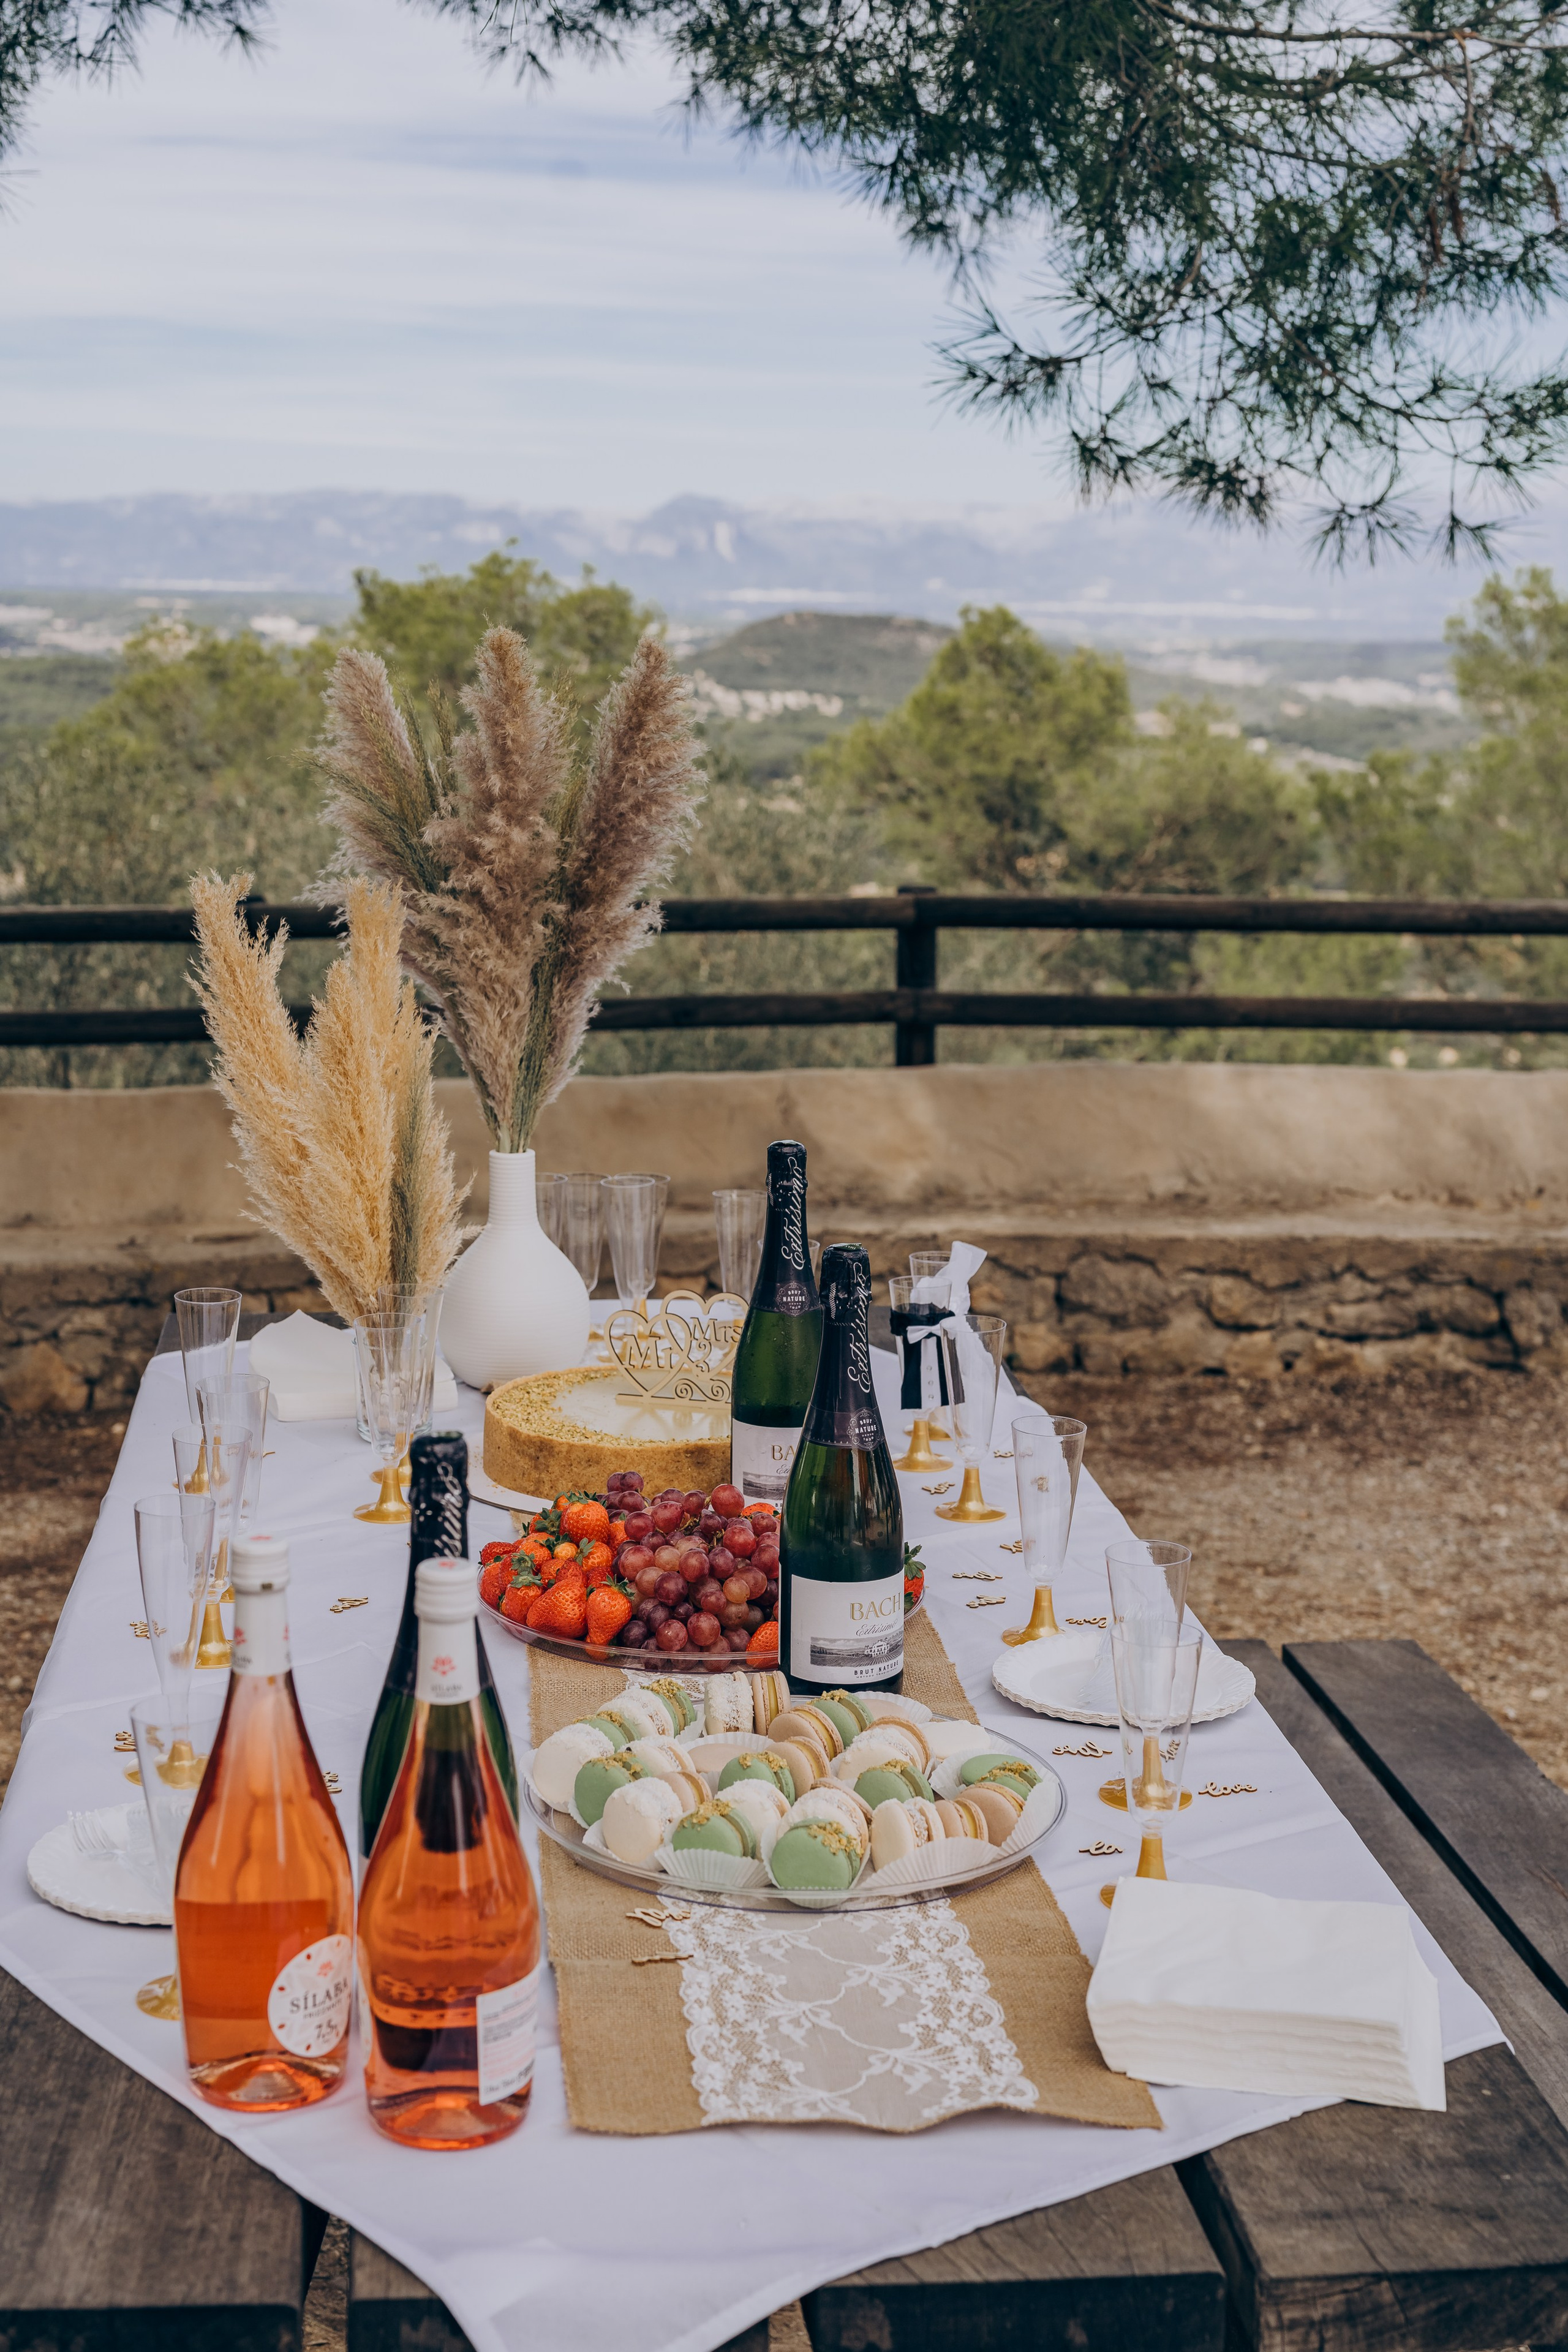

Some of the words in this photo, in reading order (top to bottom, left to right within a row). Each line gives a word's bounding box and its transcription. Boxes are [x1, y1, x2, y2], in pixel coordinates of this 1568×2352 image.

[623, 1333, 676, 1370] Mr
[855, 1425, 876, 1434] NATURE
[771, 1444, 796, 1461] BA
[850, 1592, 901, 1621] BACH
[878, 1660, 899, 1672] NATURE
[1199, 1782, 1257, 1797] love
